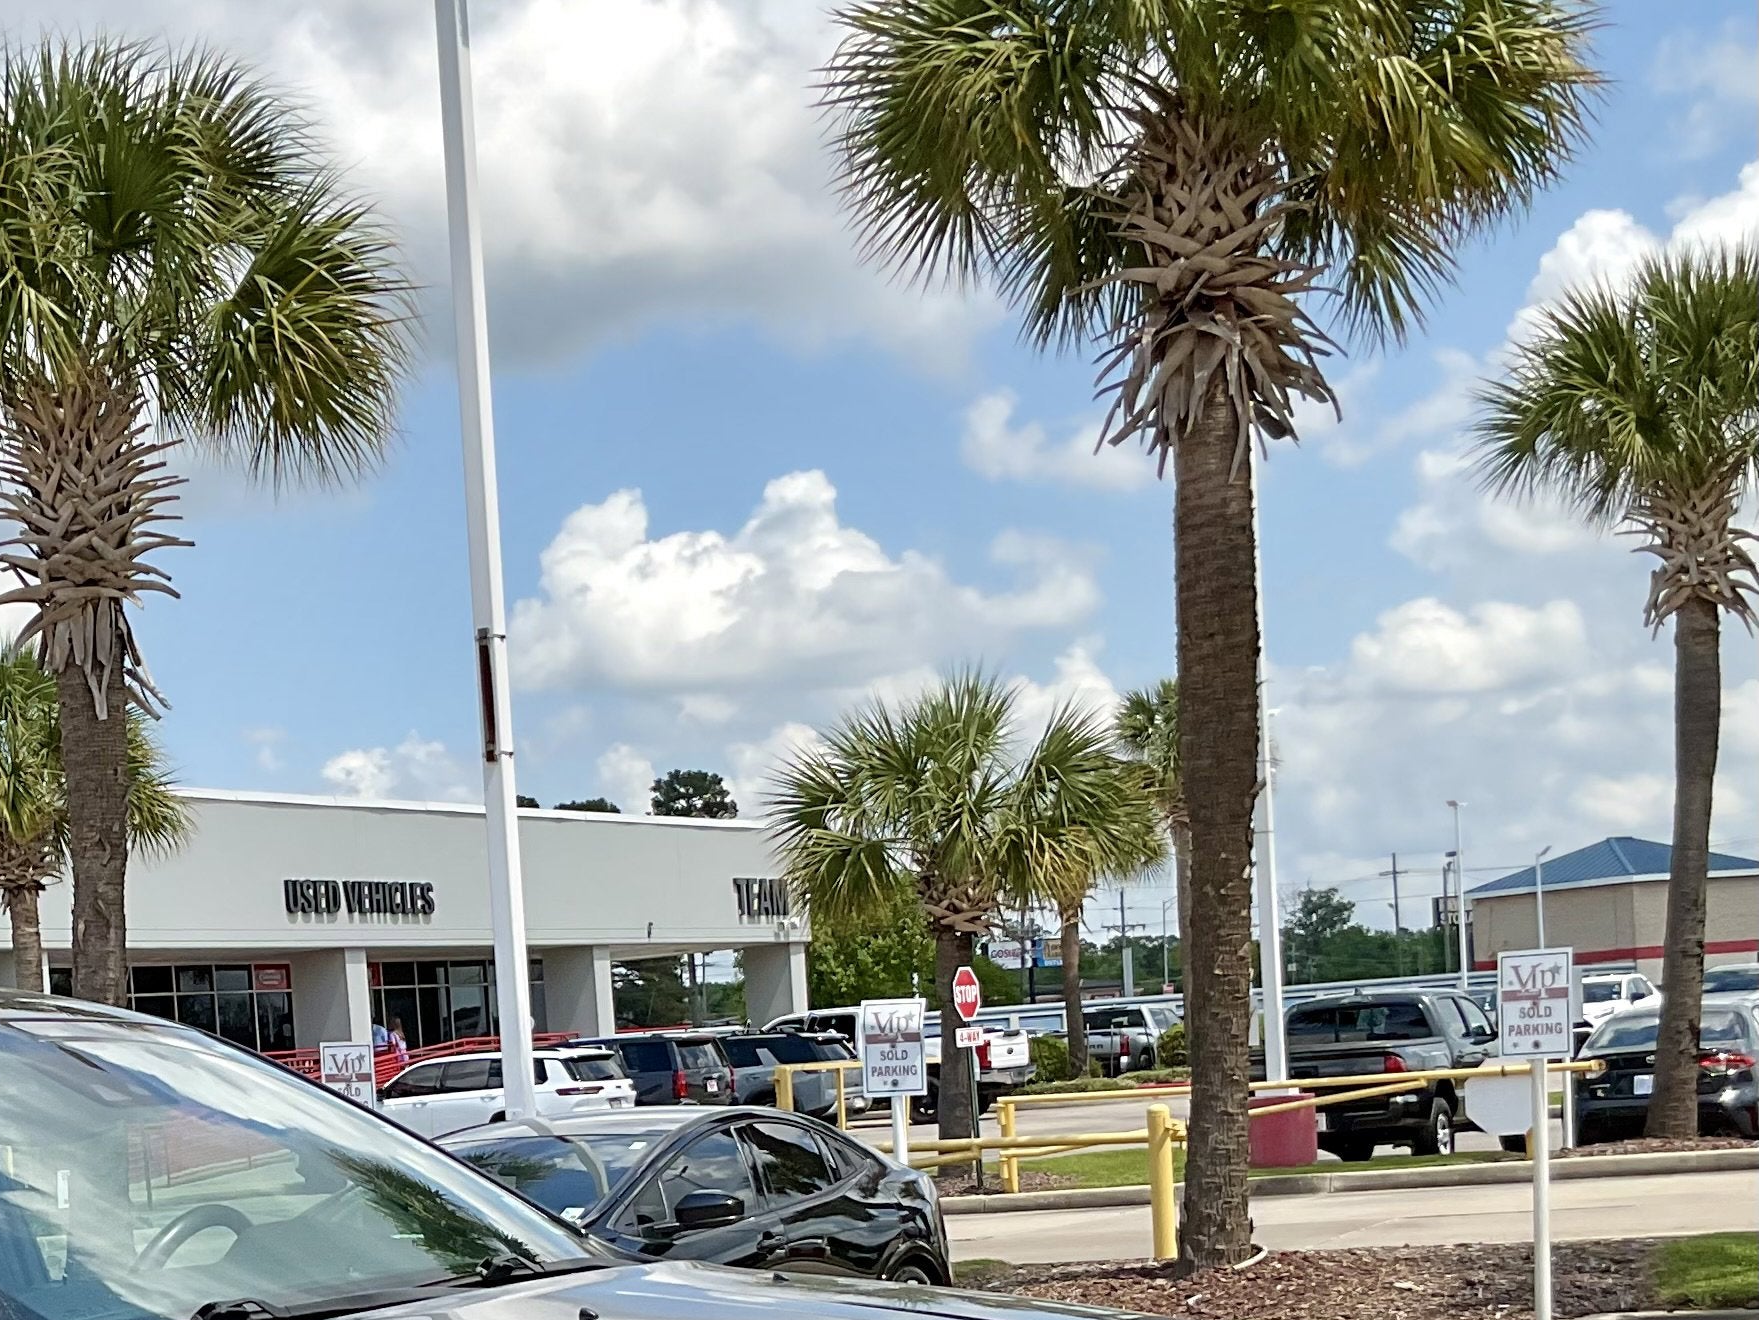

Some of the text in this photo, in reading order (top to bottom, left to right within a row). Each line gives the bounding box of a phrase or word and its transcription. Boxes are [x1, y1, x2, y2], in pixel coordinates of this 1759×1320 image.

[284, 880, 435, 915] USED VEHICLES
[733, 878, 789, 916] TEAM
[955, 985, 978, 1004] STOP
[1519, 1006, 1552, 1019] SOLD
[959, 1029, 980, 1043] 4-WAY
[1508, 1022, 1563, 1037] PARKING
[880, 1050, 908, 1061] SOLD
[871, 1065, 918, 1078] PARKING
